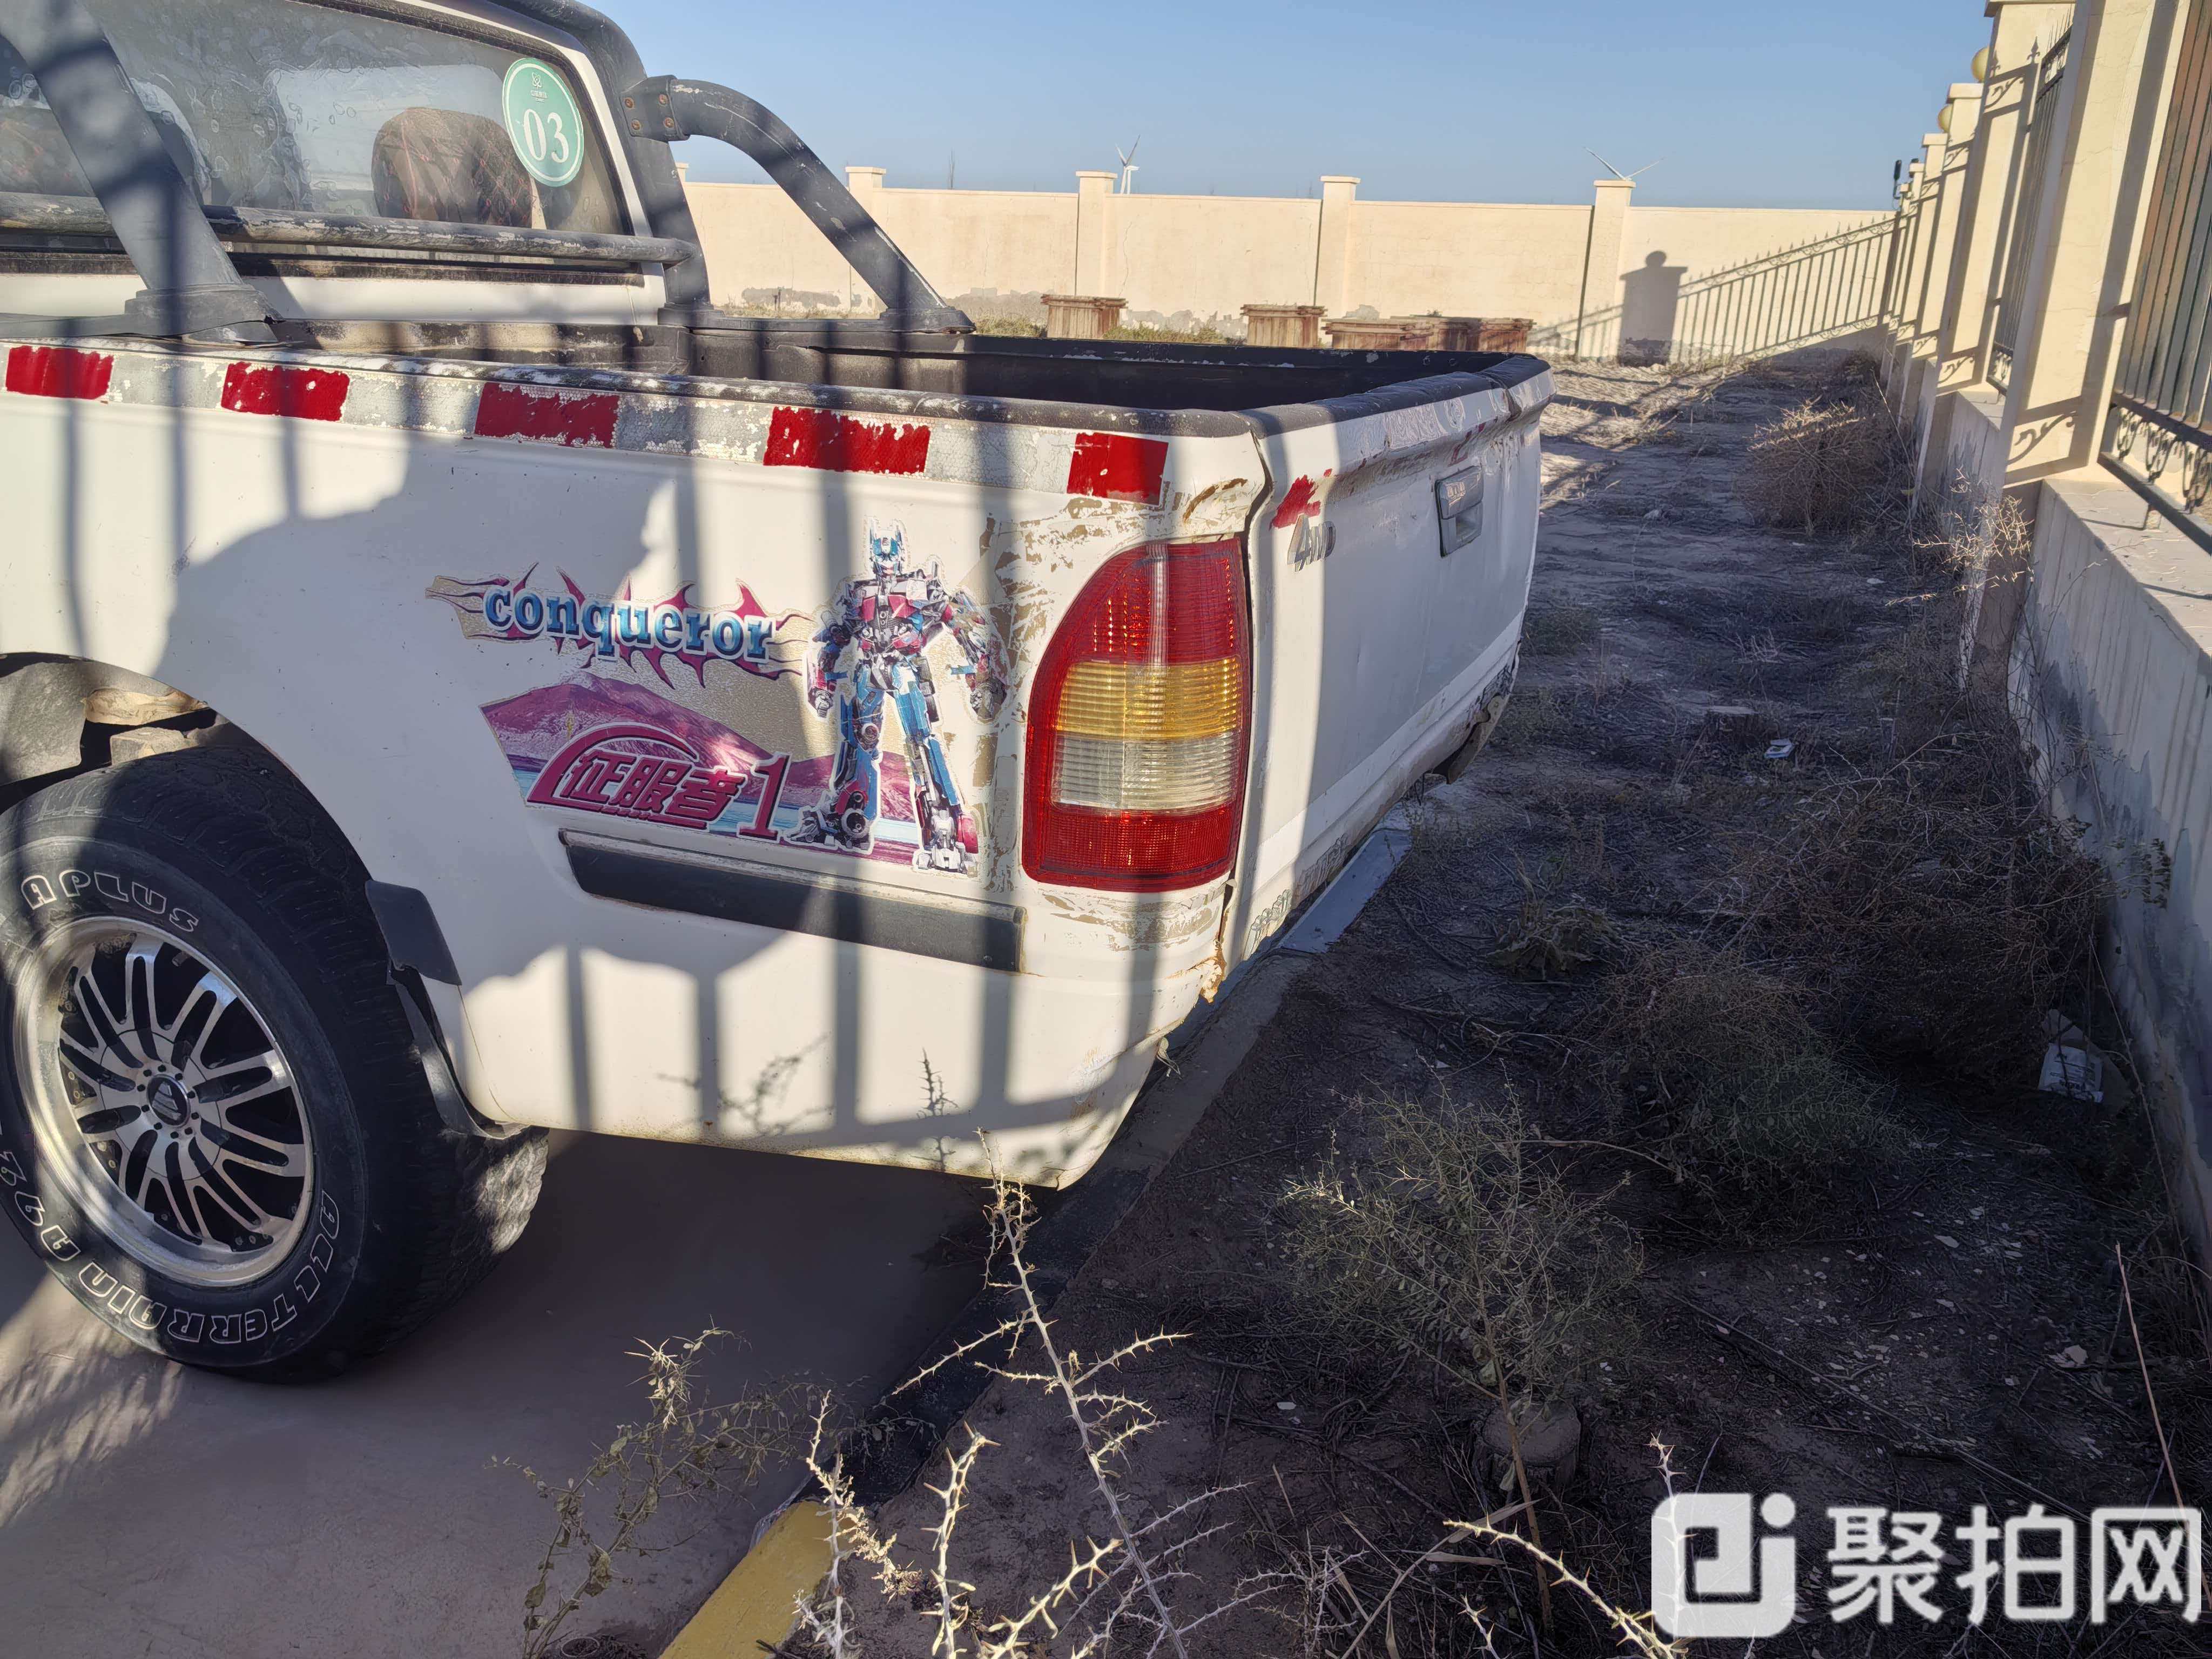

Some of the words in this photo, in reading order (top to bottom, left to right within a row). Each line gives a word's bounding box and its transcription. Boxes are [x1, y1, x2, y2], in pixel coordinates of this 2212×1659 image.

[523, 108, 569, 163] 03
[21, 869, 199, 932] APLUS
[0, 1117, 81, 1262] A92
[293, 1190, 340, 1303] ALL
[78, 1262, 298, 1344] TERRAIN
